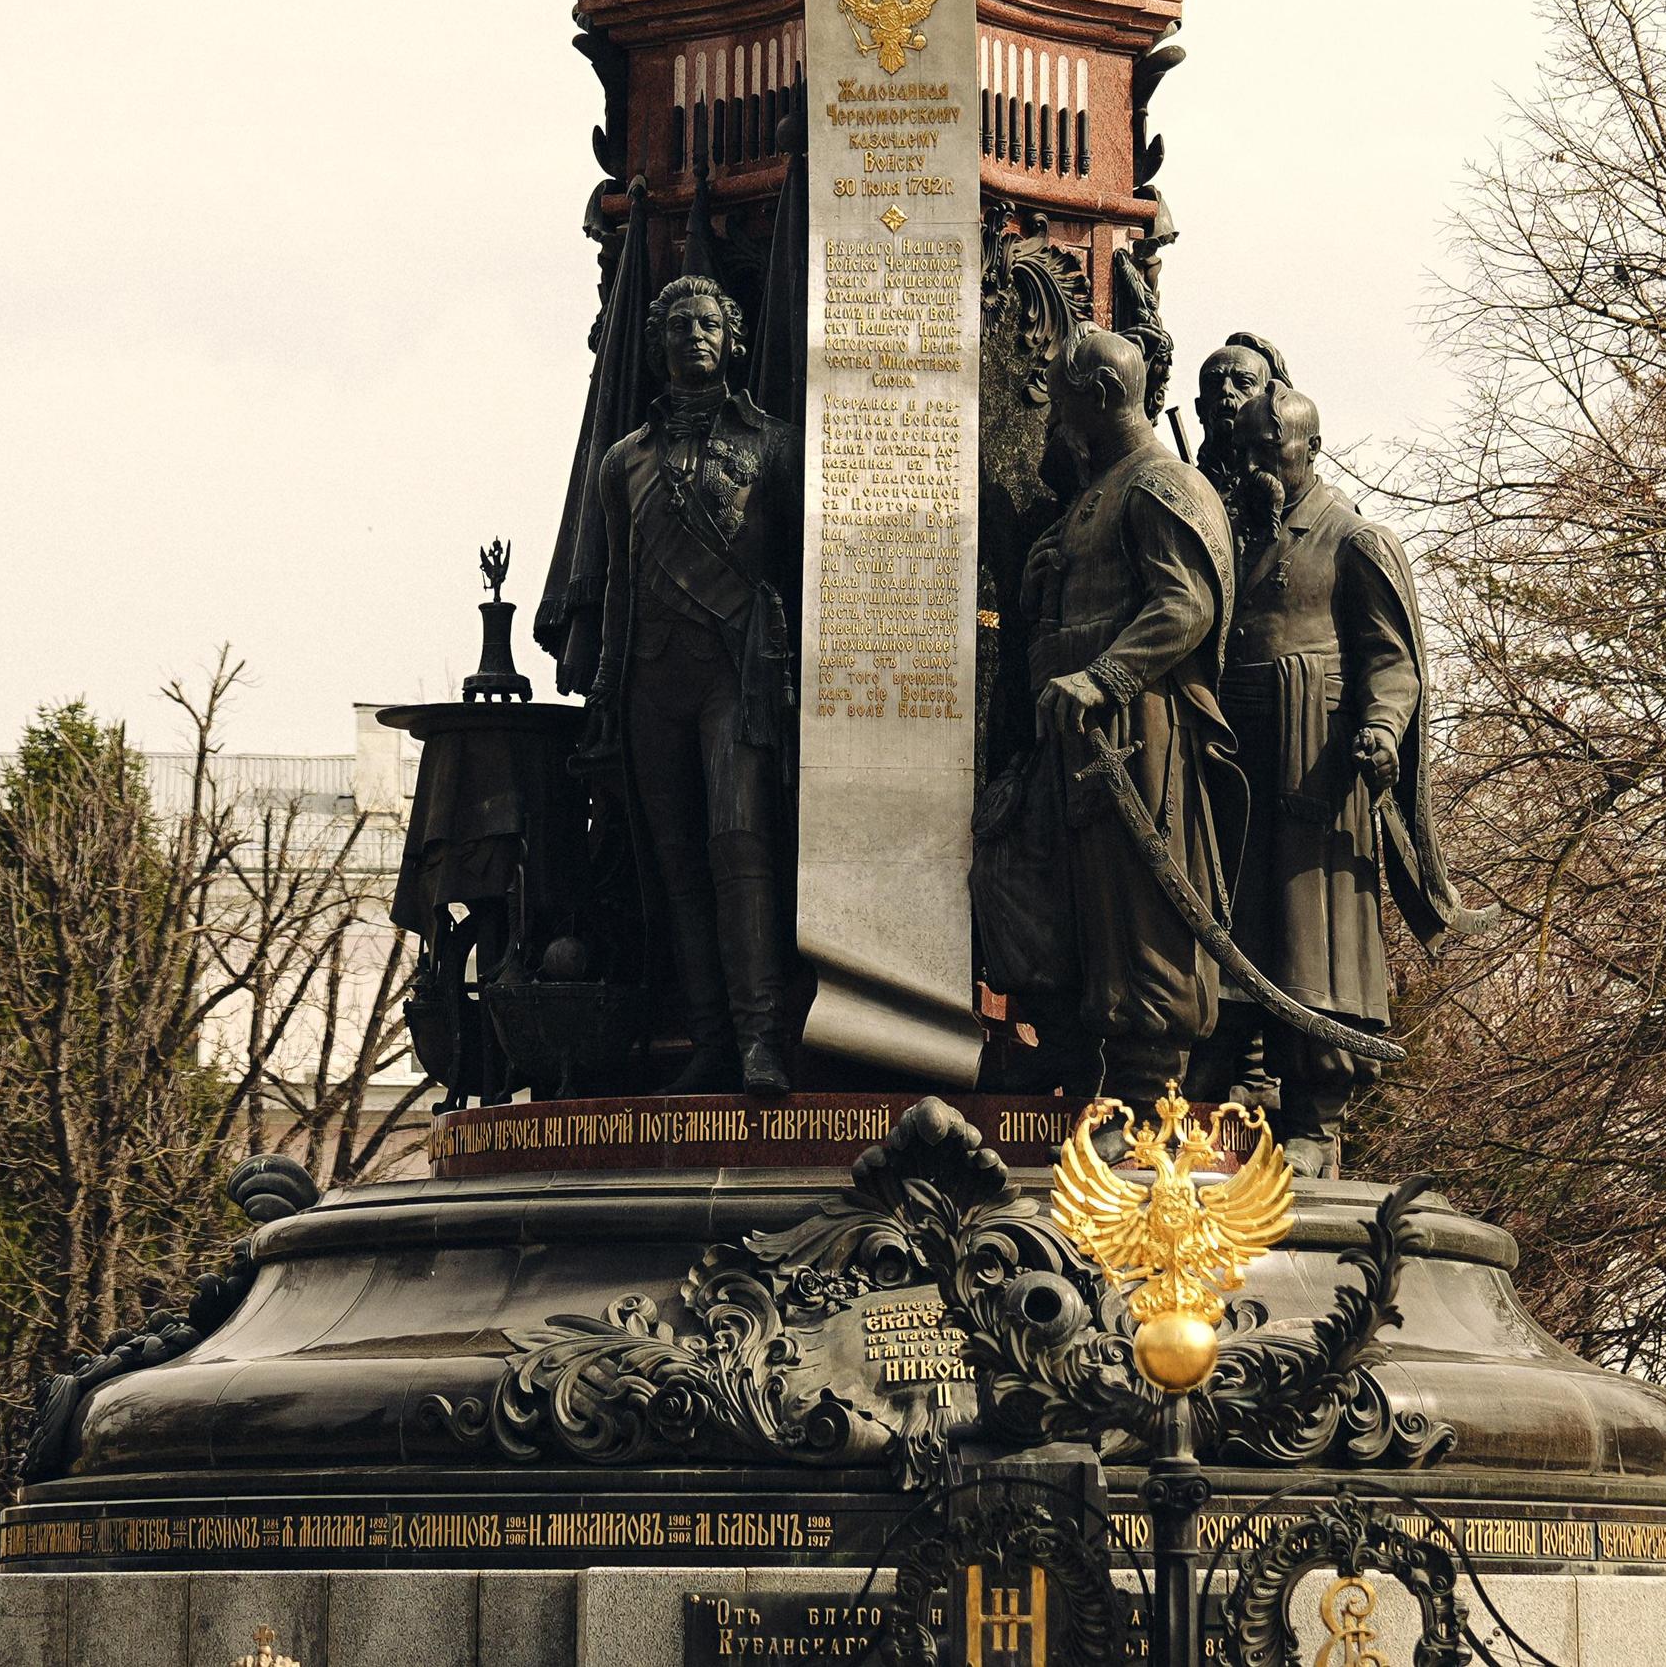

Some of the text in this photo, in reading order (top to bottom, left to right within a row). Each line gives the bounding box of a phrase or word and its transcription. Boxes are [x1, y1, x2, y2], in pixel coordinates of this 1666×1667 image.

[834, 178, 856, 196] 30
[906, 176, 943, 195] 1792
[505, 1516, 527, 1528] 1904
[668, 1515, 691, 1526] 1906
[807, 1516, 831, 1528] 1908
[807, 1535, 830, 1547] 1917
